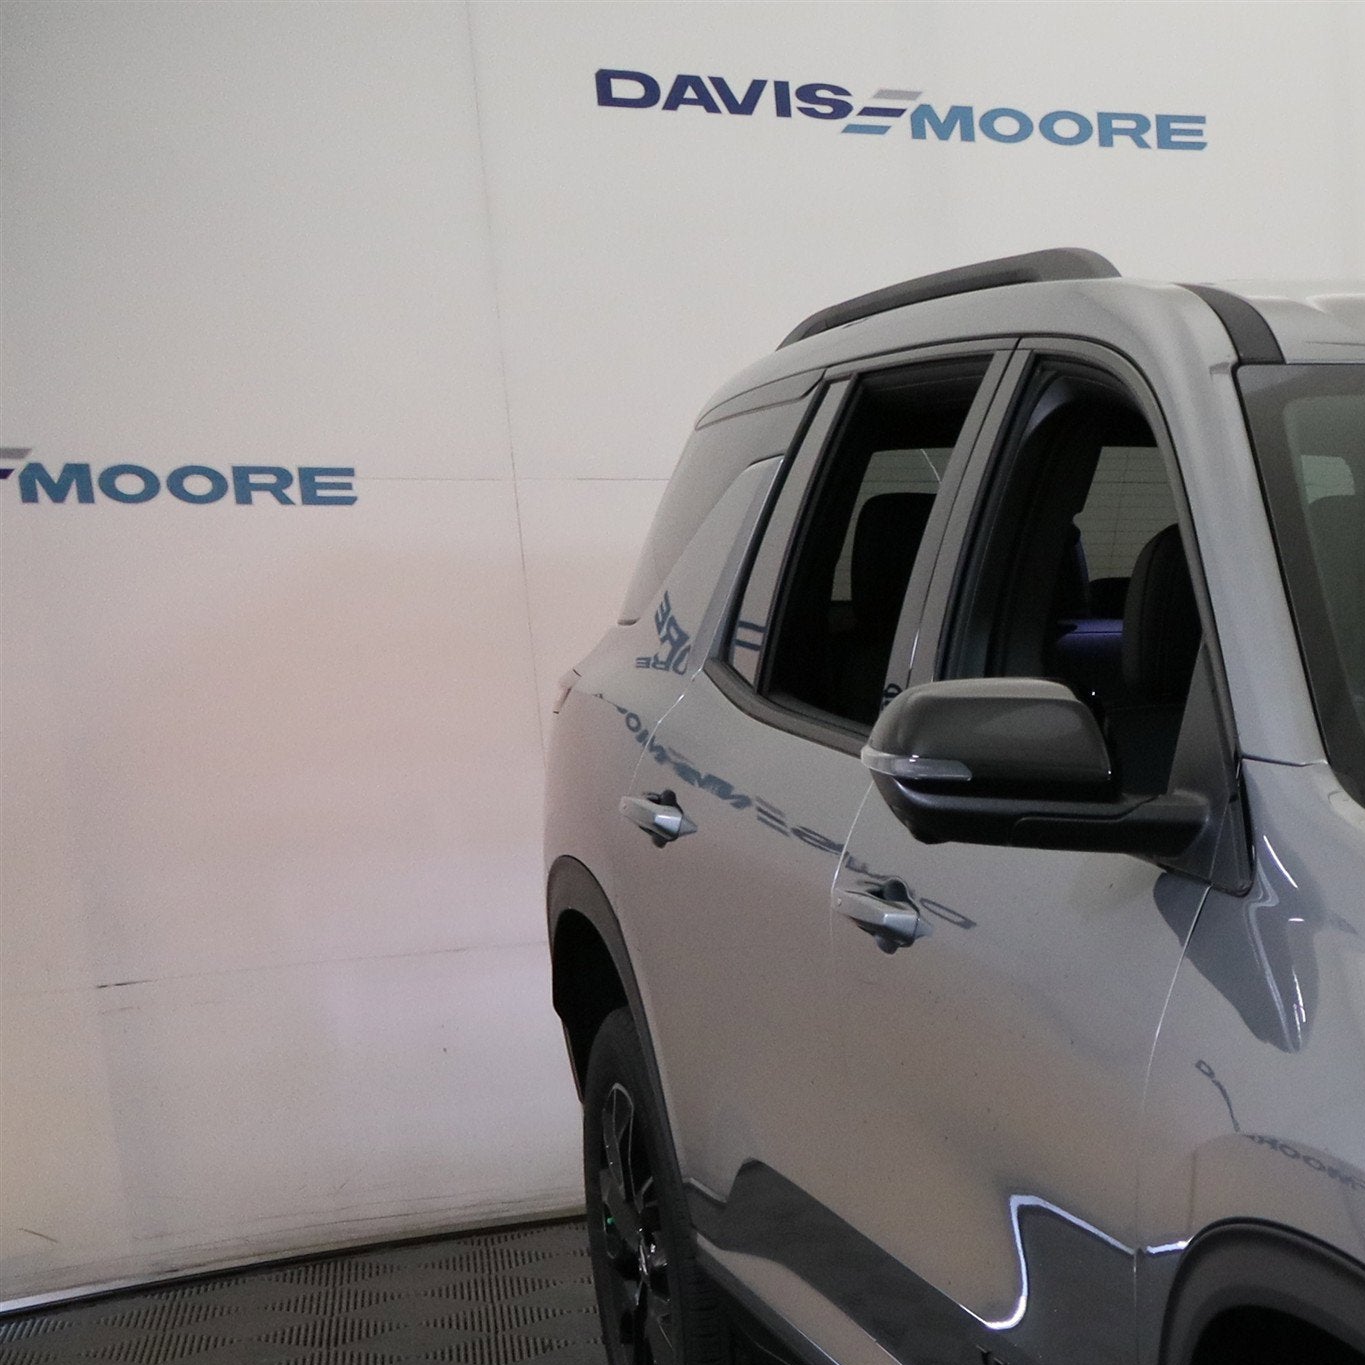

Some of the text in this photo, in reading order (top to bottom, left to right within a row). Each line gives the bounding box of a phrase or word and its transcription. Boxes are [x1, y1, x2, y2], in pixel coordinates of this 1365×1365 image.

[594, 68, 1208, 151] DAVIS MOORE
[18, 462, 358, 506] MOORE
